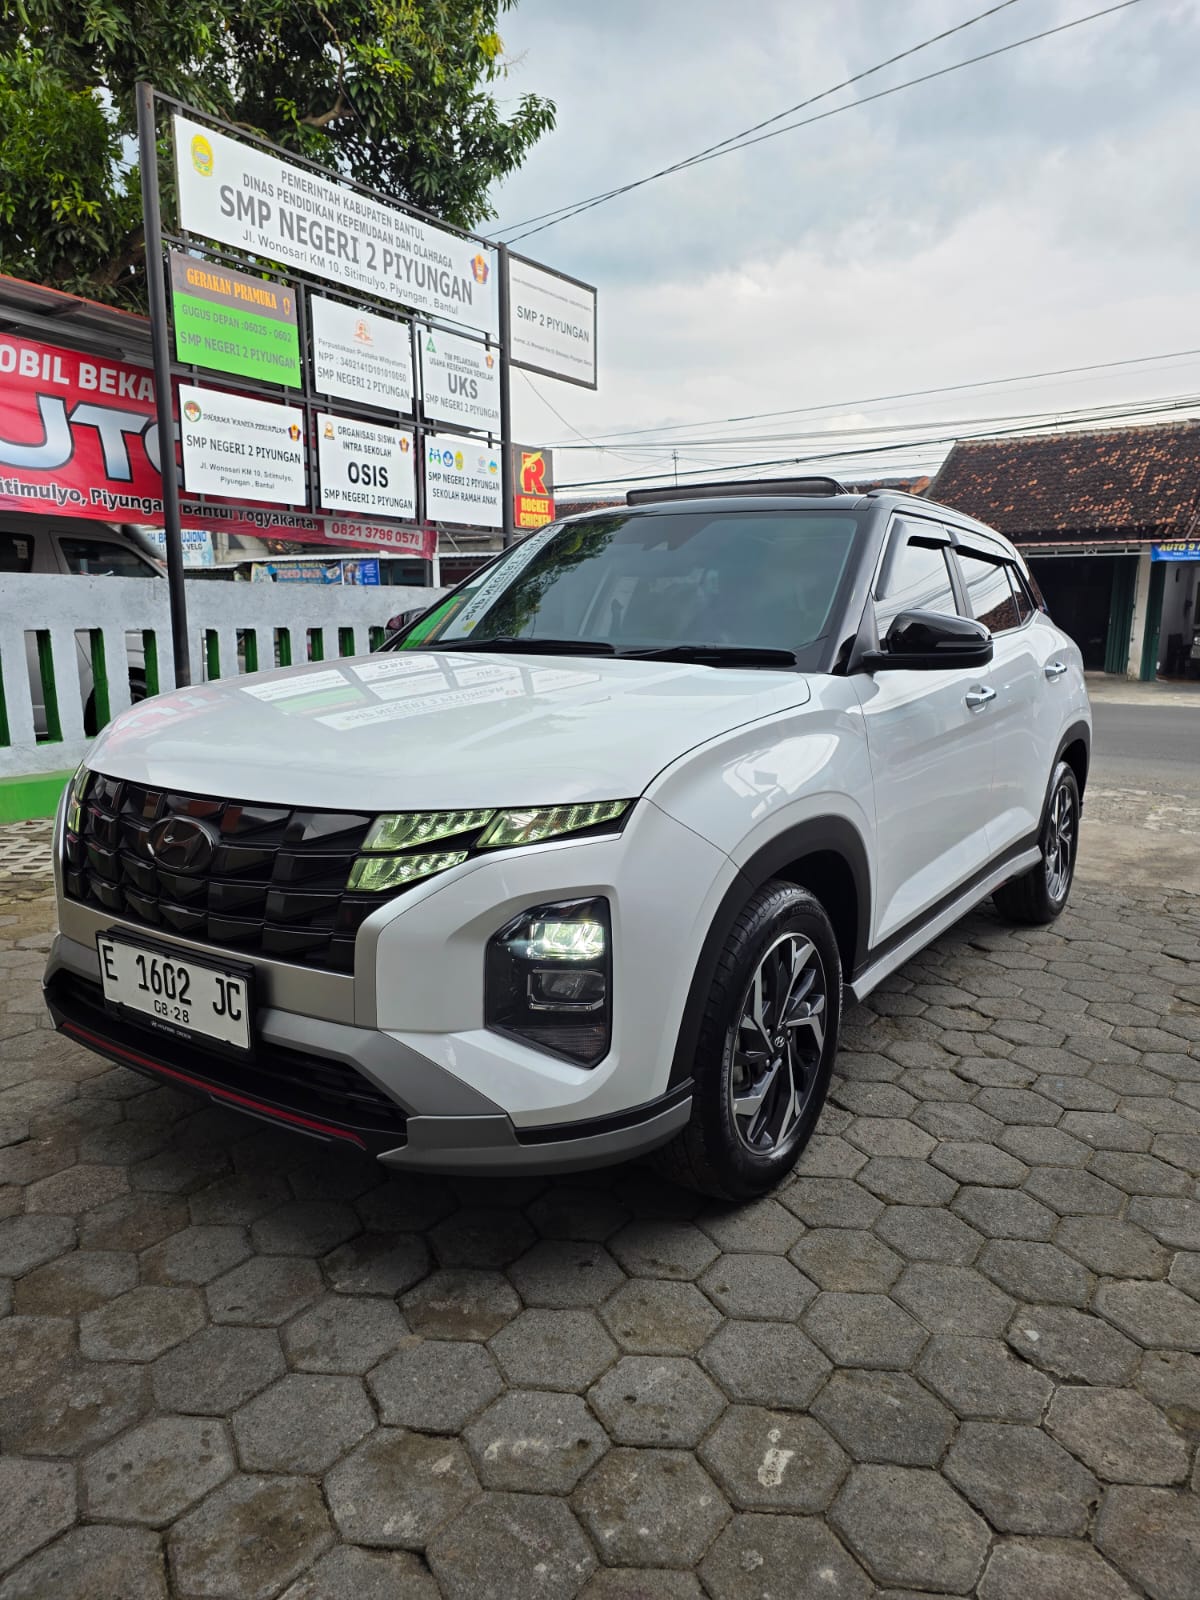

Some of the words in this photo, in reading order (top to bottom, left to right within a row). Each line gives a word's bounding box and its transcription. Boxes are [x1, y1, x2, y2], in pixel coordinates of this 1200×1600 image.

[281, 170, 341, 207] PEMERINTAH
[343, 196, 392, 227] KABUPATEN
[394, 218, 425, 242] BANTUL
[242, 172, 274, 198] DINAS
[276, 187, 334, 222] PENDIDIKAN
[336, 211, 394, 247] KEPEMUDAAN
[395, 236, 412, 254] DAN
[413, 243, 453, 270] OLAHRAGA
[219, 184, 272, 230] SMP
[278, 206, 360, 265] NEGERI
[365, 240, 378, 271] 2
[382, 247, 473, 306] PIYUNGAN
[242, 229, 255, 244] Jl.
[257, 233, 308, 262] Wonosari
[309, 253, 326, 270] KM
[328, 260, 342, 276] 10,
[344, 265, 388, 292] Sitimulyo,
[389, 281, 428, 304] Piyungan
[433, 297, 459, 314] Bantul
[186, 267, 232, 296] GERAKAN
[233, 281, 277, 310] PRAMUKA
[182, 303, 211, 321] GUGUS
[213, 312, 240, 329] DEPAN
[516, 305, 538, 323] SMP
[539, 313, 545, 327] 2
[546, 316, 590, 343] PIYUNGAN
[180, 330, 202, 346] SMP
[204, 336, 240, 357] NEGERI
[242, 345, 249, 359] 2
[250, 348, 296, 369] PIYUNGAN
[78, 361, 156, 403] BEKA
[317, 365, 334, 381] SMP
[336, 371, 365, 388] NEGERI
[366, 379, 372, 390] 2
[373, 381, 410, 400] PIYUNGAN
[447, 372, 478, 400] UKS
[425, 392, 439, 404] SMP
[440, 396, 464, 412] NEGERI
[464, 403, 469, 413] 2
[469, 404, 499, 419] PIYUNGAN
[337, 425, 376, 441] ORGANISASI
[376, 433, 396, 445] SISWA
[186, 434, 207, 449] SMP
[209, 438, 245, 456] NEGERI
[248, 445, 254, 457] 2
[255, 446, 301, 465] PIYUNGAN
[342, 441, 362, 452] INTRA
[363, 444, 392, 457] SEKOLAH
[209, 463, 241, 474] Wonosari
[241, 468, 252, 476] KM
[220, 475, 251, 487] Piyungan
[255, 480, 275, 489] Bantul
[347, 461, 389, 488] OSIS
[428, 471, 442, 482] SMP
[442, 473, 465, 486] NEGERI
[465, 477, 470, 487] 2
[471, 478, 500, 491] PIYUNGAN
[90, 488, 163, 515] Piyunga
[181, 503, 233, 520] Bantul
[239, 508, 318, 531] Yogyakarta.
[324, 488, 340, 500] SMP
[341, 490, 370, 504] NEGERI
[371, 494, 376, 505] 2
[377, 495, 413, 510] PIYUNGAN
[432, 487, 460, 500] SEKOLAH
[460, 491, 481, 503] RAMAH
[481, 495, 497, 505] ANAK
[520, 496, 550, 514] ROCKET
[331, 522, 363, 537] 0821
[365, 526, 393, 541] 3796
[395, 530, 420, 546] 0578
[1160, 543, 1187, 552] AUTO
[1188, 543, 1196, 551] 9
[102, 944, 119, 982] E
[135, 953, 193, 1006] 1602
[212, 977, 242, 1021] JC
